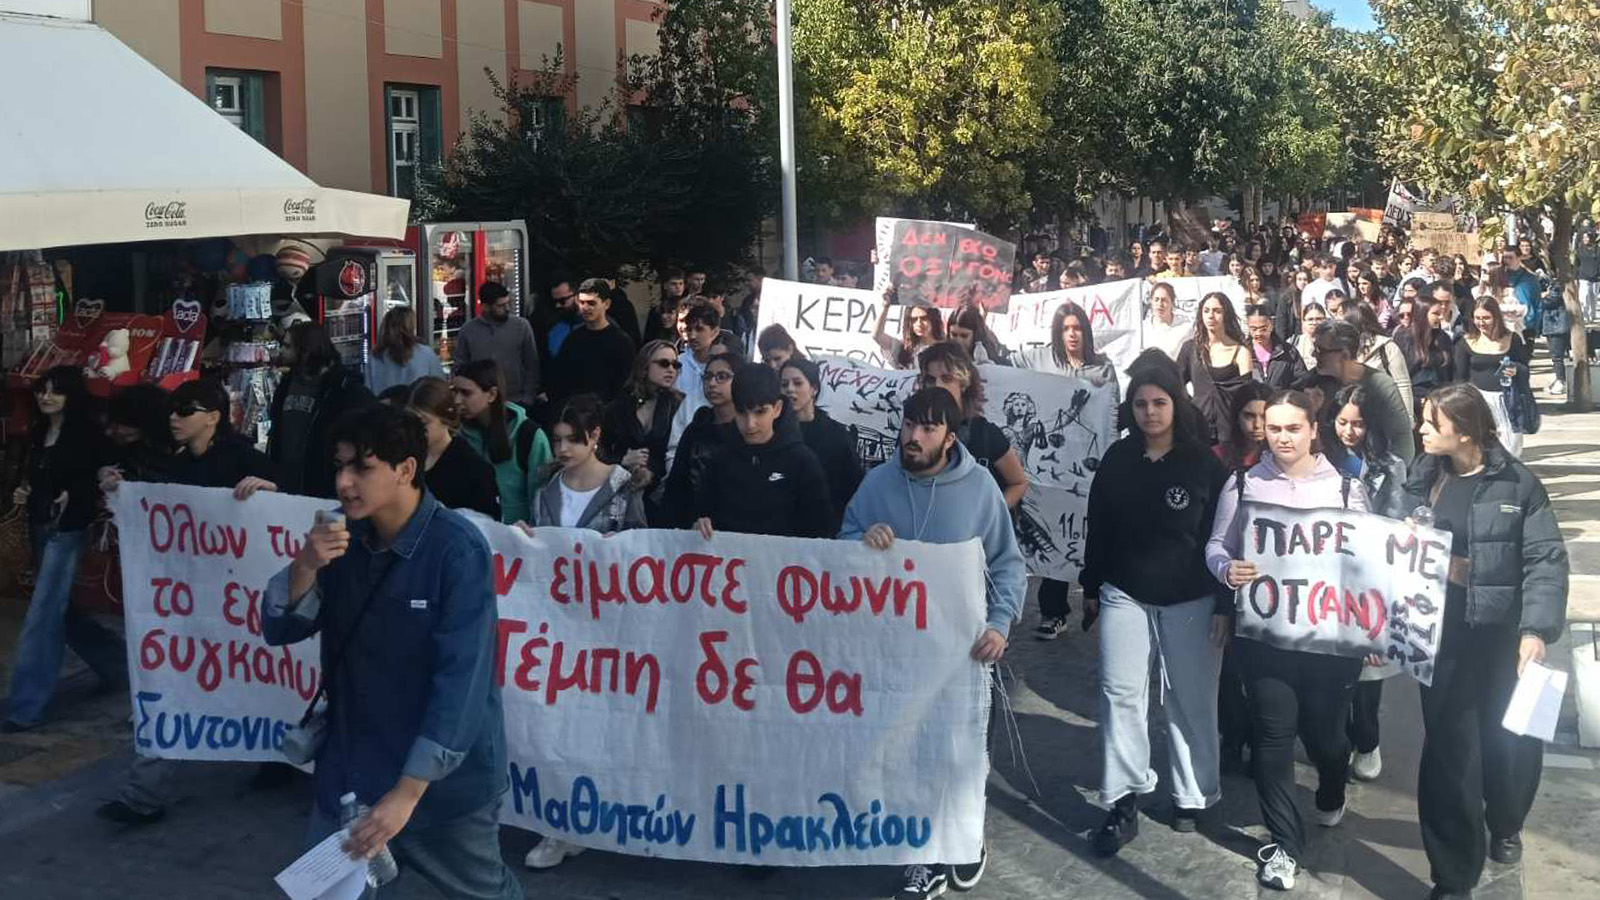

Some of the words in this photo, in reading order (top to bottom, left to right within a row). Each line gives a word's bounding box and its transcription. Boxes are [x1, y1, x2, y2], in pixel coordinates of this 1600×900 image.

[145, 201, 186, 220] Coca-Cola
[550, 542, 747, 620] είμαστε
[776, 558, 927, 630] φωνή
[1253, 517, 1356, 557] ΠΑΡΕ
[1385, 533, 1446, 580] ΜΕ
[151, 577, 193, 618] το
[495, 618, 660, 714] Τέμπη
[696, 630, 759, 711] δε
[786, 649, 864, 717] θα
[509, 761, 696, 847] Μαθητών
[714, 783, 932, 856] Ηρακλείου
